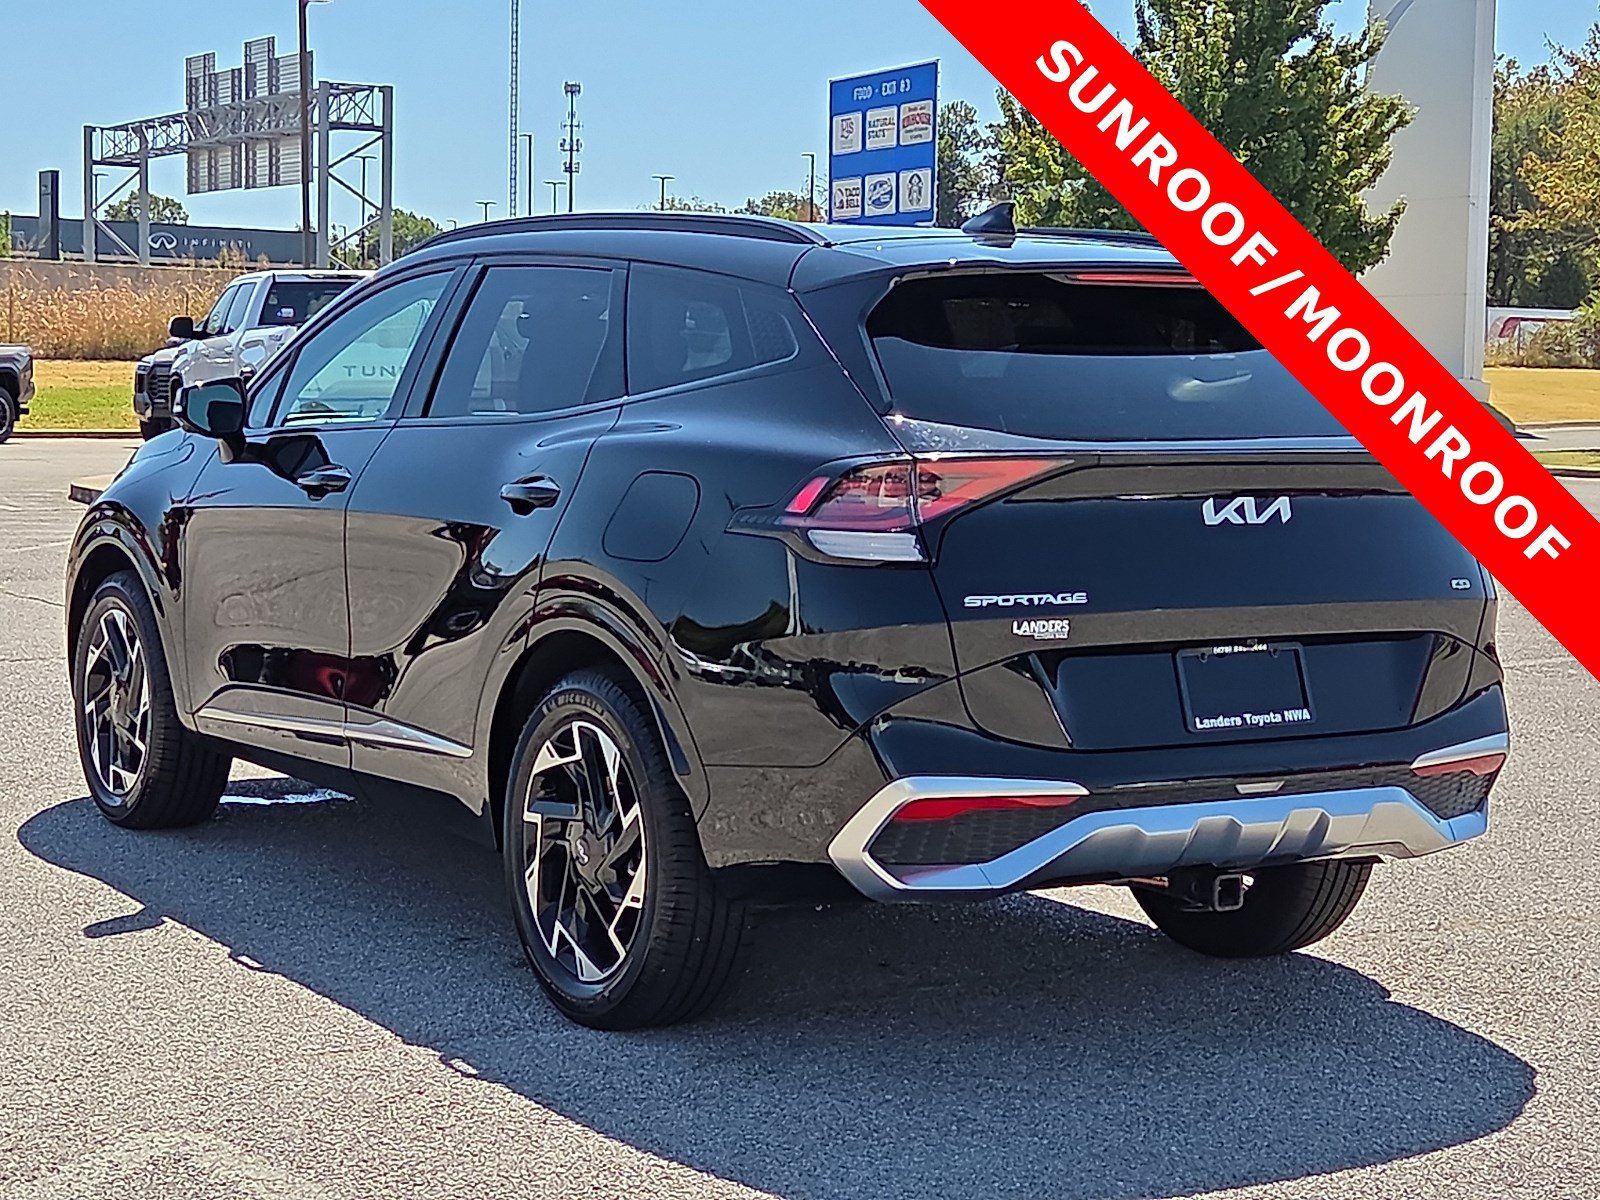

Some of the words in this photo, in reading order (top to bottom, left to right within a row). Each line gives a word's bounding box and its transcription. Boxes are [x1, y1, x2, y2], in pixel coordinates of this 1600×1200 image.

[854, 86, 873, 101] FOOD
[882, 80, 897, 96] EXIT
[868, 117, 896, 128] NATURAL
[845, 187, 860, 197] TACO
[845, 198, 860, 209] BELL
[183, 237, 252, 249] INFINITI
[1202, 496, 1292, 525] KIA
[963, 592, 1088, 607] SPORTAGE
[1012, 619, 1070, 635] LANDERS
[1195, 715, 1243, 729] Landers
[1243, 711, 1282, 727] Toyota
[1283, 708, 1311, 722] NWA
